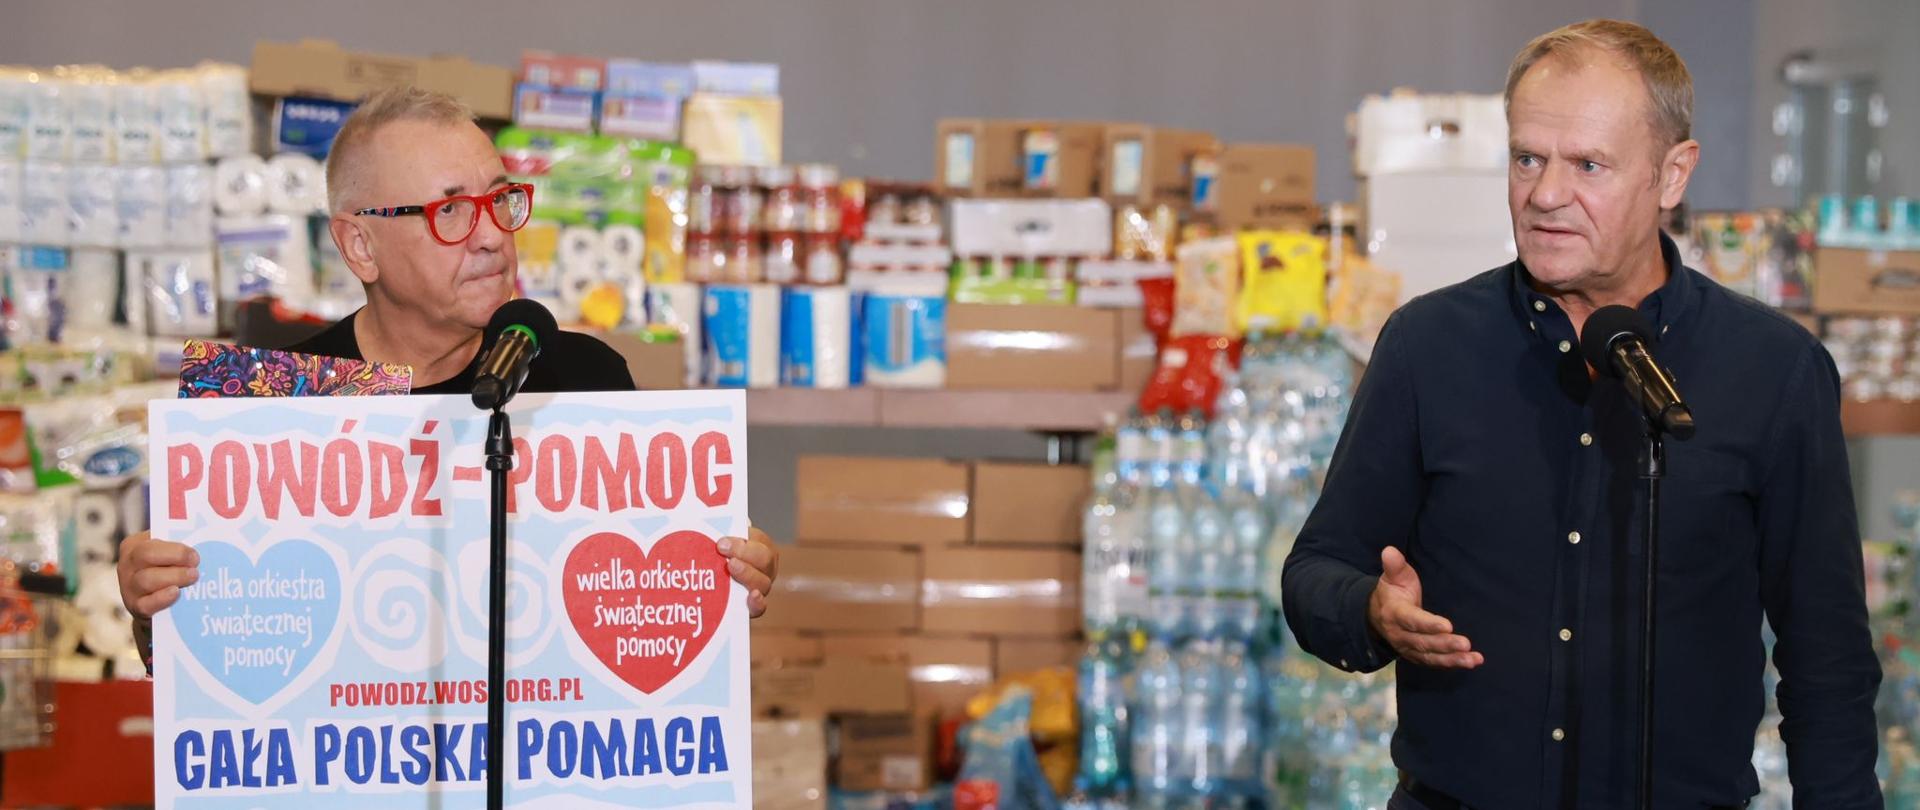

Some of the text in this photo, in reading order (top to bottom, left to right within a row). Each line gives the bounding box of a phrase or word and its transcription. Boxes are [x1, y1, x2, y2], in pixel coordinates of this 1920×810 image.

[168, 419, 442, 520] POWÓDŹ
[248, 568, 326, 601] orkiestra
[576, 558, 716, 592] wielka orkiestra
[200, 603, 313, 648] świątecznej
[593, 594, 704, 639] świątecznej
[224, 644, 296, 677] pomocy
[616, 634, 687, 667] pomocy
[174, 728, 297, 791] CAŁA
[518, 716, 728, 781] POMAGA
